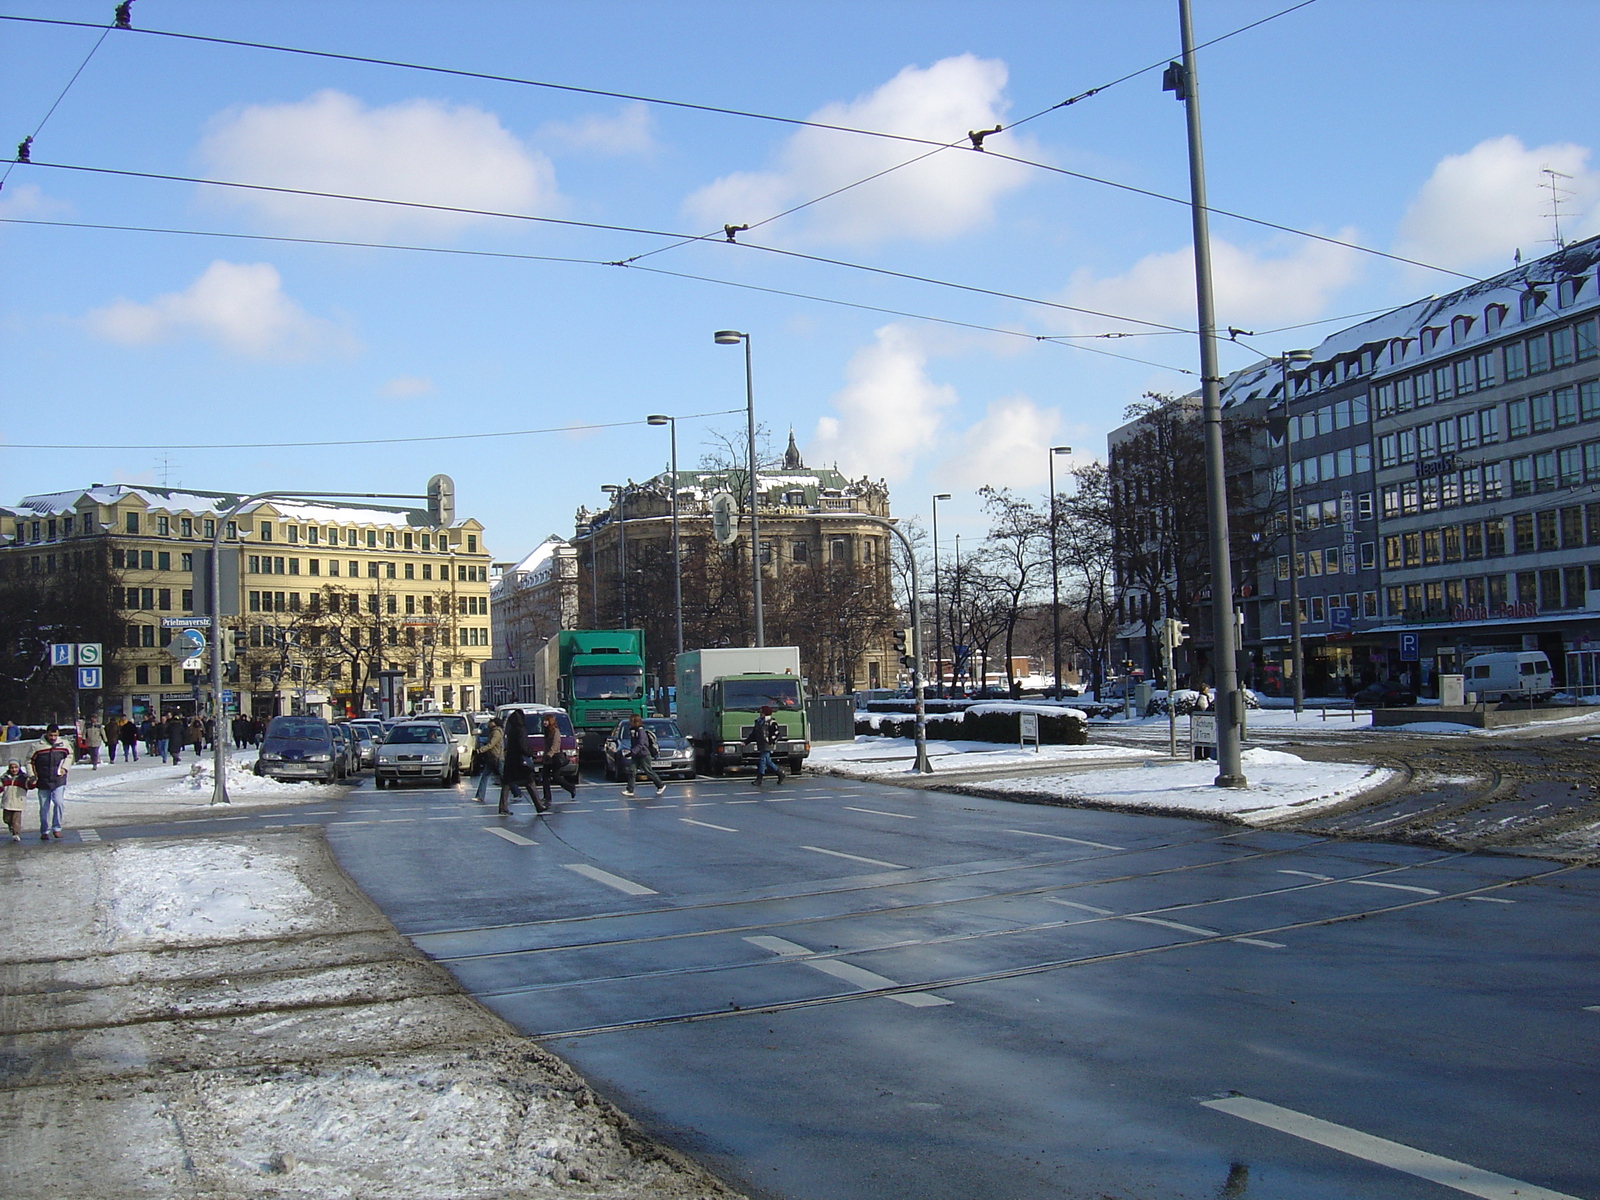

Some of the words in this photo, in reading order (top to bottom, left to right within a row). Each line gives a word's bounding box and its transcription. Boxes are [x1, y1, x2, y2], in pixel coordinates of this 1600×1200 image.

[779, 505, 808, 515] BANK
[1251, 533, 1260, 542] W
[1343, 491, 1355, 574] APOTHEKE
[1336, 610, 1347, 622] P
[1453, 603, 1489, 621] Gloria
[1499, 600, 1540, 618] Palast
[162, 618, 211, 627] Prielmayerstr.
[1403, 635, 1415, 651] P
[81, 645, 98, 663] S
[81, 670, 97, 687] U
[1196, 720, 1214, 730] Achtung
[1199, 730, 1211, 739] Tram
